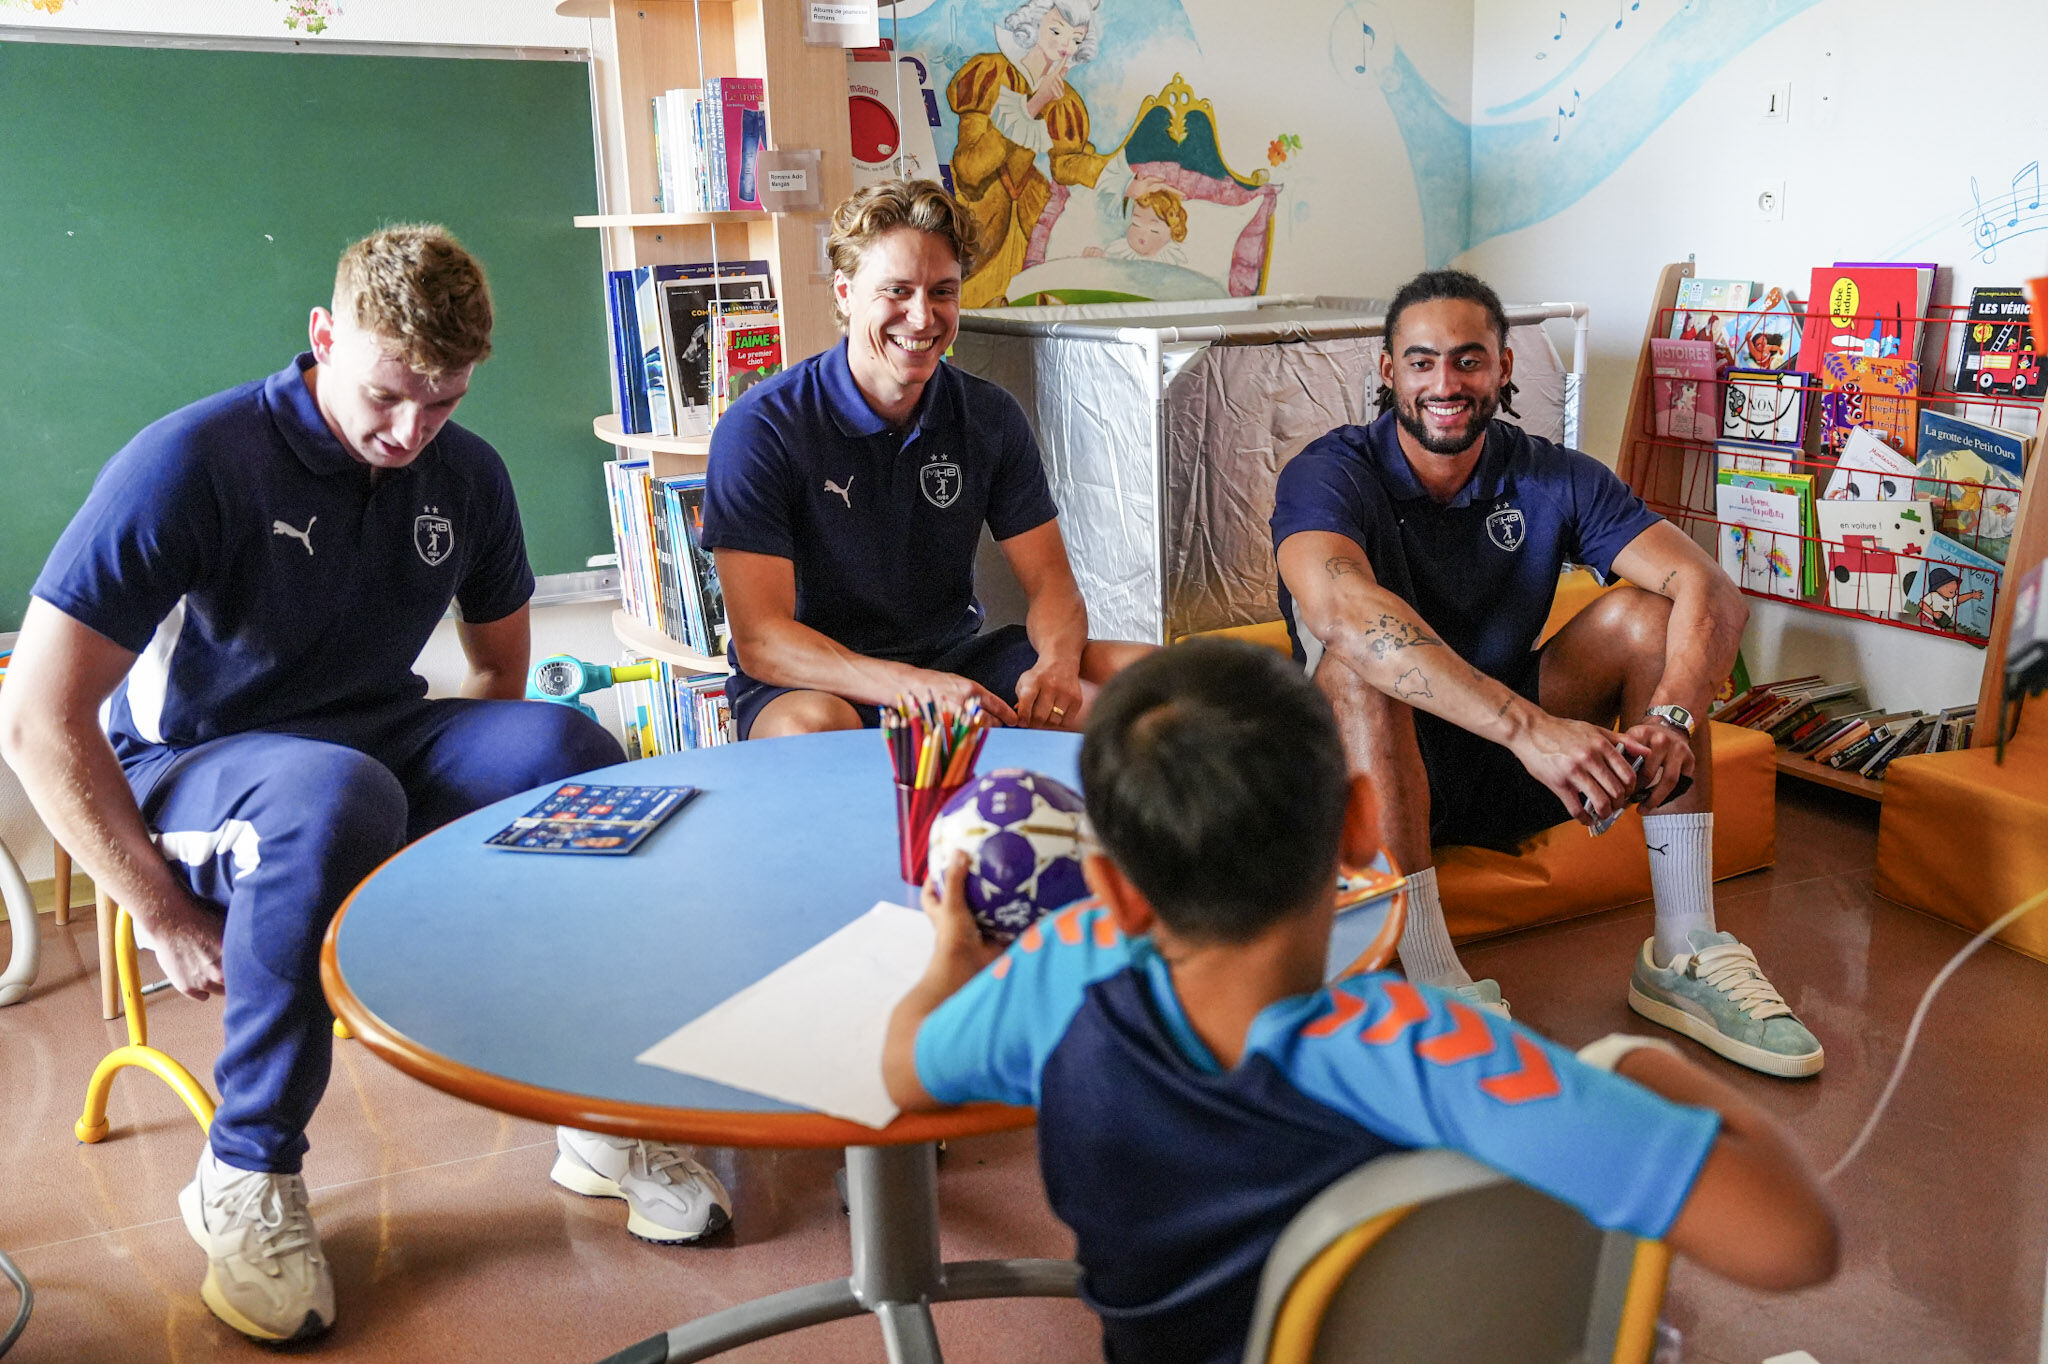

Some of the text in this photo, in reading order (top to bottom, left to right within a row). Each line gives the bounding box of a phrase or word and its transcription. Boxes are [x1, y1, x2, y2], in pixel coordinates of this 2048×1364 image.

[850, 84, 879, 97] maman
[1833, 287, 1844, 316] Bébé
[1978, 301, 2033, 315] LES VÉHIC
[737, 349, 773, 360] Le premier
[1652, 345, 1710, 361] HISTOIRES
[746, 357, 764, 366] chiot
[1924, 424, 2016, 461] La grotte de Petit Ours
[926, 468, 957, 479] MHB
[1851, 521, 1878, 530] voiture
